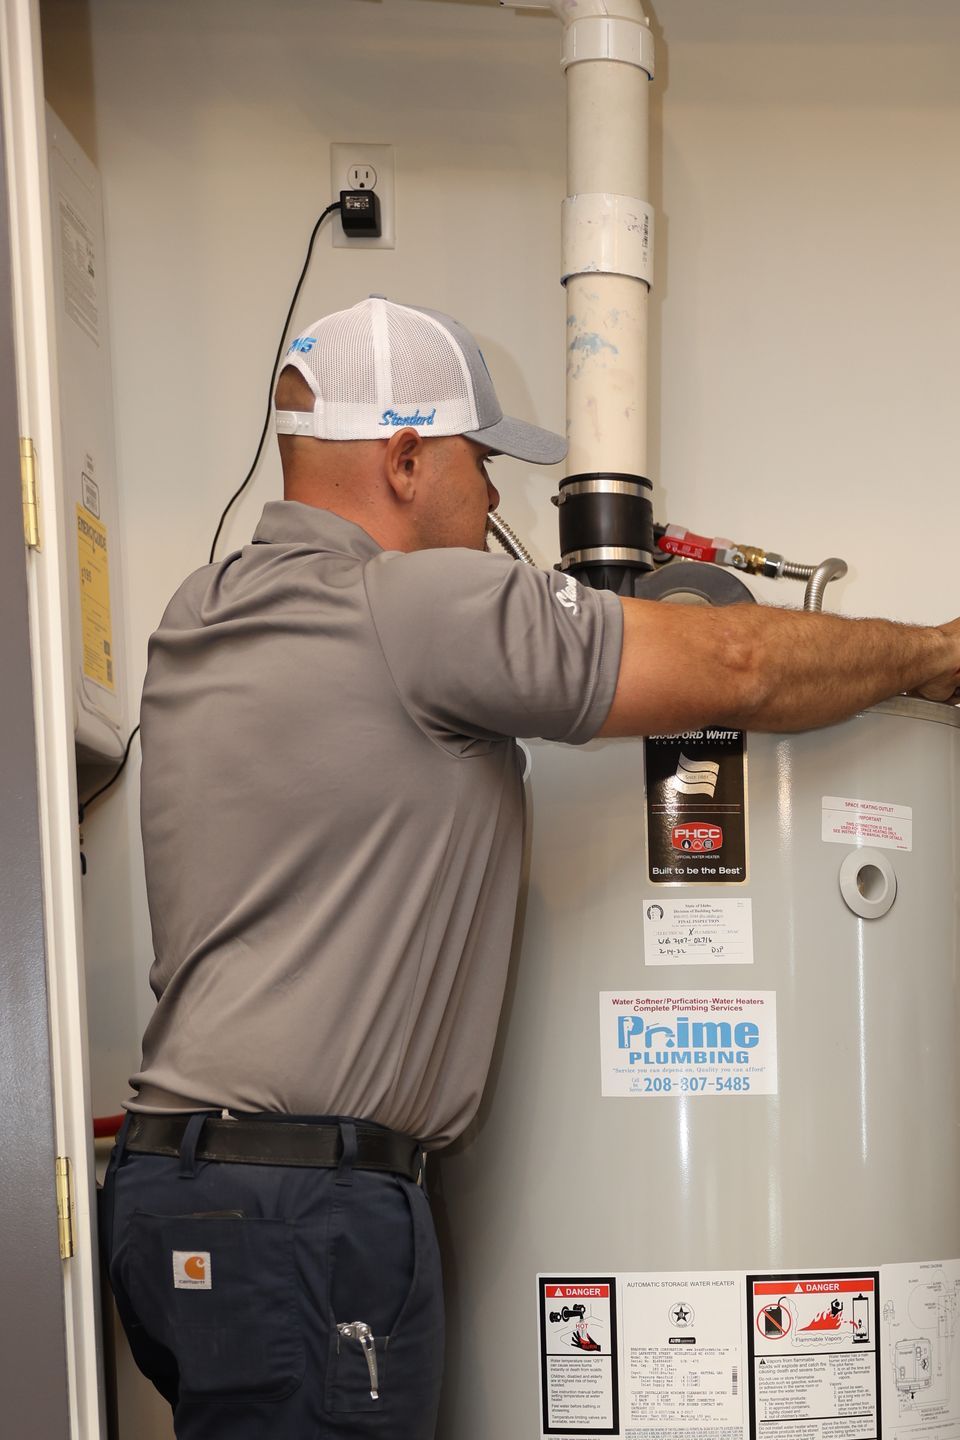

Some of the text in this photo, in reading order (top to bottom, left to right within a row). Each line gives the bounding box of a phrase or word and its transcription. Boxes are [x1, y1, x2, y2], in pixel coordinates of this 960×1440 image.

[379, 408, 436, 426] Standard
[706, 730, 739, 740] WHITE
[674, 829, 720, 839] PHCC
[652, 867, 672, 875] Built
[675, 867, 684, 875] to
[687, 867, 698, 875] be
[701, 867, 716, 875] the
[633, 1004, 670, 1012] Complete
[671, 1004, 708, 1012] Plumbing
[617, 1016, 760, 1049] Prime
[629, 1051, 749, 1064] PLUMBING
[566, 1288, 601, 1296] DANGER
[806, 1283, 840, 1292] DANGER
